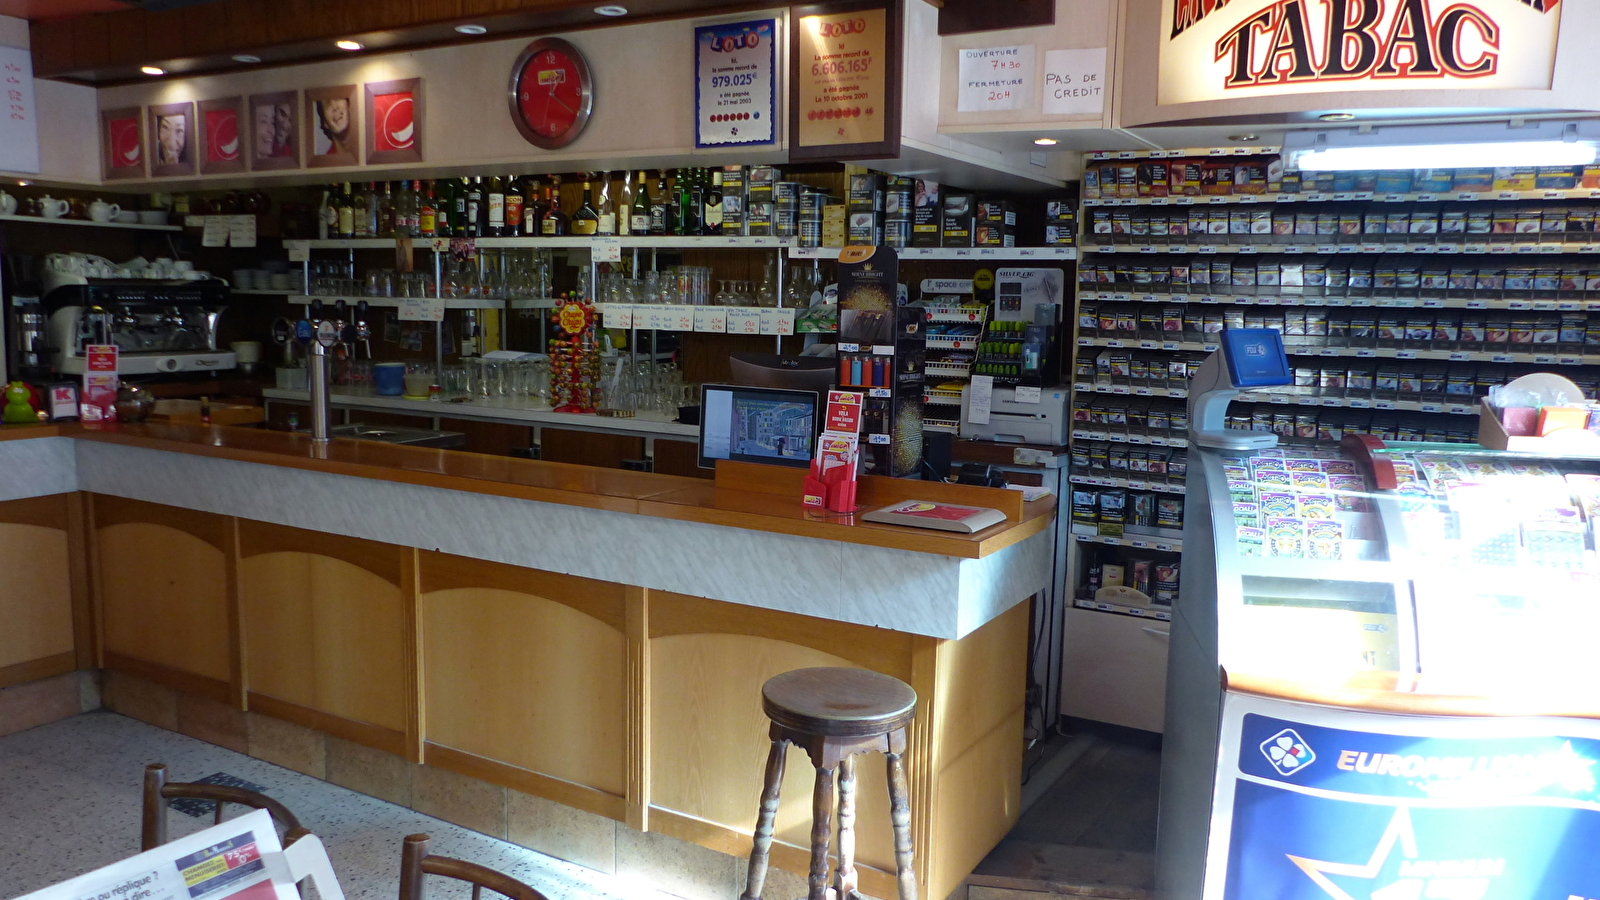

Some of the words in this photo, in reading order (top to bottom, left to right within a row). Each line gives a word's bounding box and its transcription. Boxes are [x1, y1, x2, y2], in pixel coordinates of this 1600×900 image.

[819, 18, 866, 37] LOTO
[711, 31, 759, 53] LOTO
[1214, 0, 1500, 89] TABAC
[966, 49, 1018, 58] OUVERTURE
[546, 55, 556, 64] 12
[968, 78, 1024, 88] FERMETURE
[1045, 73, 1072, 85] PAS
[1083, 74, 1097, 83] DE
[576, 87, 581, 96] 3
[987, 91, 1010, 101] 20H
[524, 92, 529, 101] 9
[550, 123, 556, 132] 6
[1246, 346, 1257, 354] FDJ
[55, 389, 71, 400] K
[1261, 474, 1286, 483] ASTRO
[1297, 475, 1323, 484] ASTRO
[1265, 496, 1291, 505] ASTRO
[1303, 498, 1329, 507] ASTRO
[1273, 522, 1299, 531] ASTRO
[1312, 523, 1338, 533] ASTRO
[111, 874, 152, 897] réplique
[152, 871, 159, 880] ?
